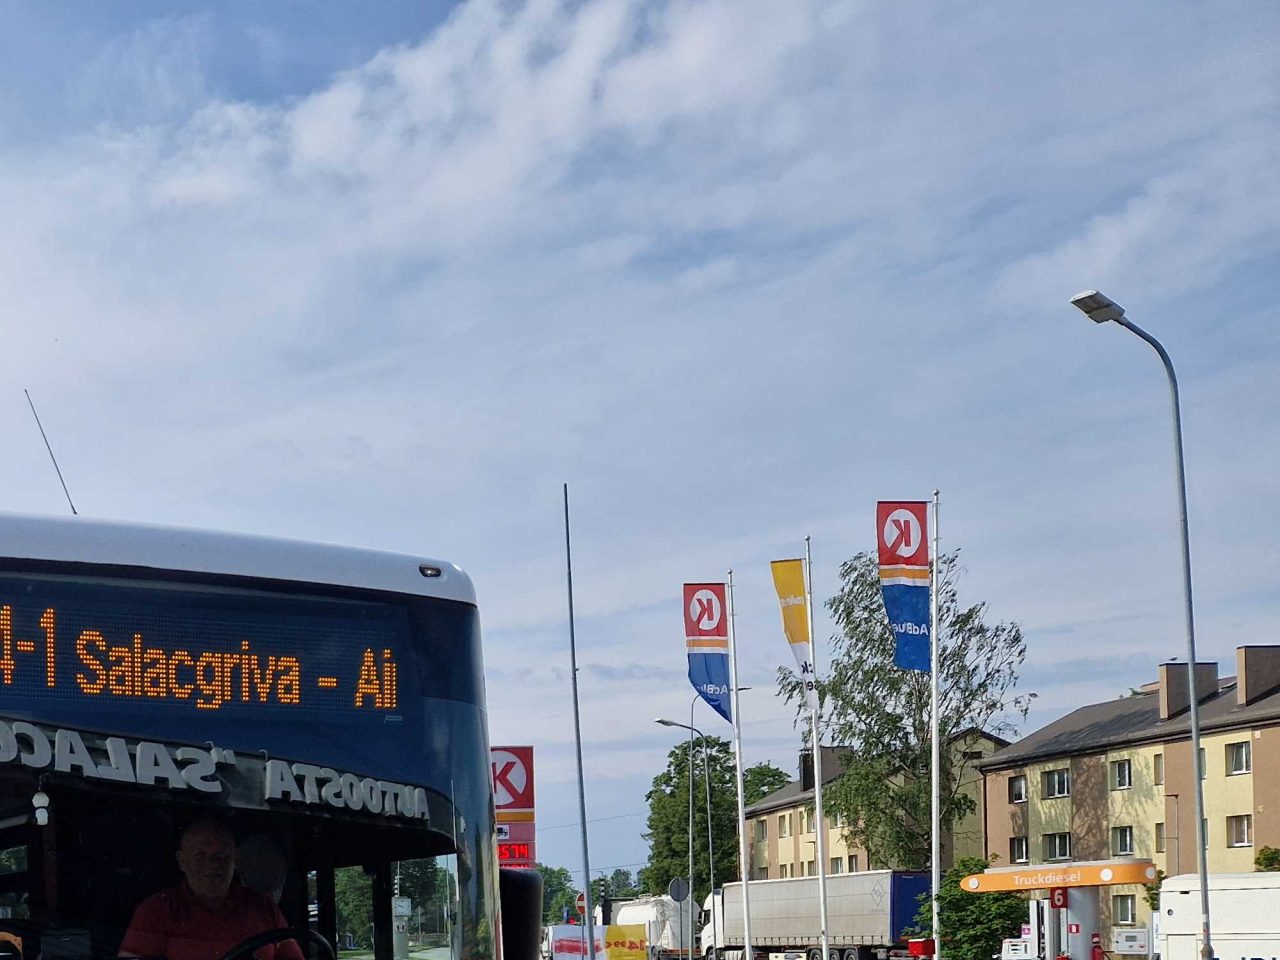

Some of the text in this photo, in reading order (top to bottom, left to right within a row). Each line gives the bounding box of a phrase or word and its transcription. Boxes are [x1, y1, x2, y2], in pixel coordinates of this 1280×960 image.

[75, 629, 301, 709] Salacgriva
[1013, 871, 1081, 886] Truckdiesel
[1053, 889, 1064, 906] 6
